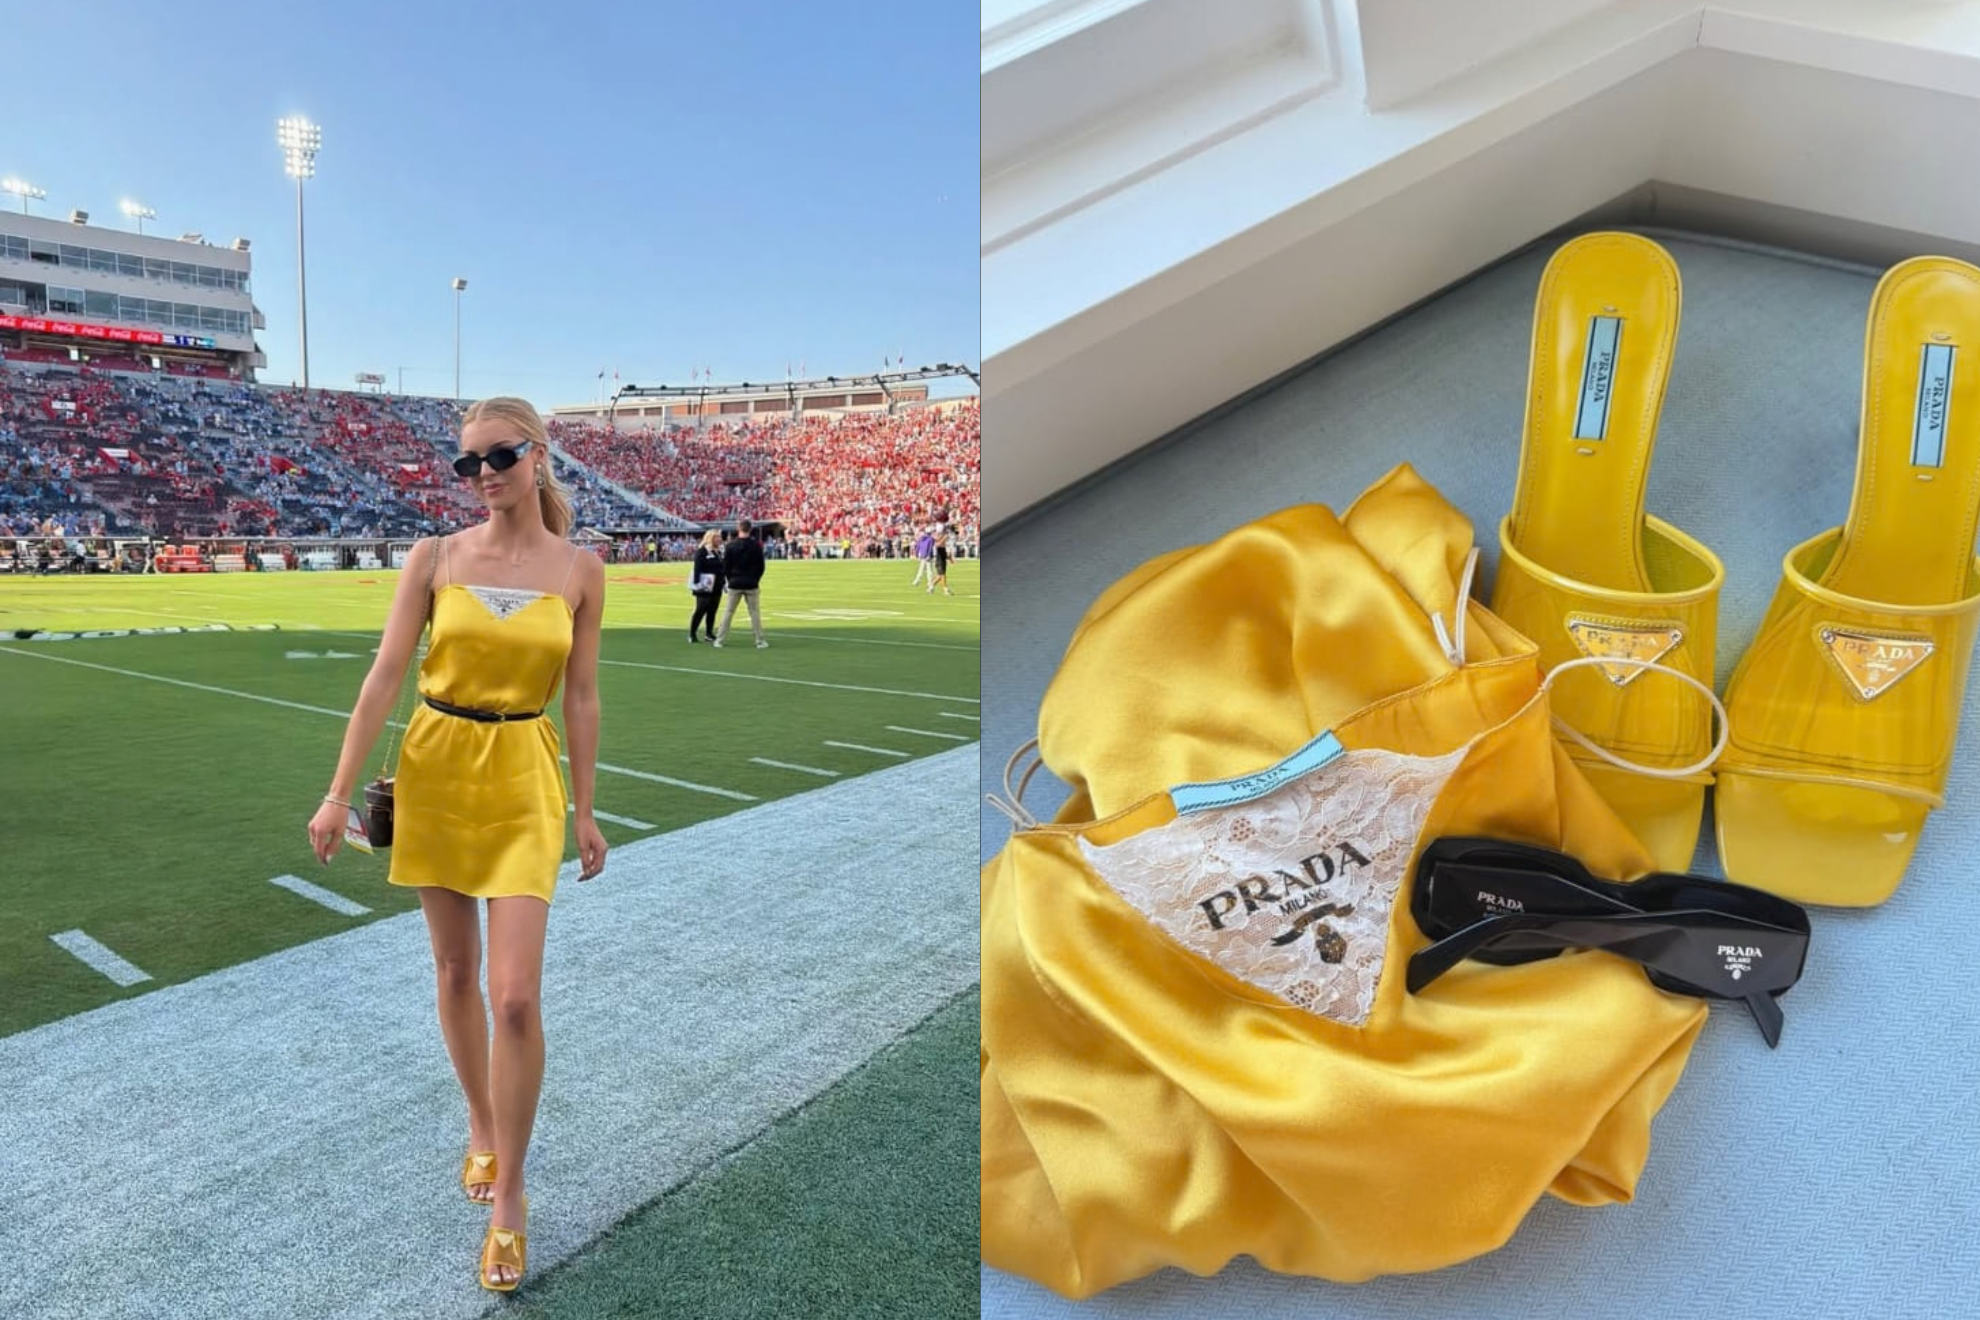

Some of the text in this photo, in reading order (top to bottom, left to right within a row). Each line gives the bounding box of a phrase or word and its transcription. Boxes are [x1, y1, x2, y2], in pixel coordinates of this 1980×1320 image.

[1594, 352, 1611, 402] PRADA
[1929, 376, 1945, 431] PRADA
[1230, 767, 1289, 791] PRADA
[1198, 841, 1372, 931] PRADA
[1279, 888, 1329, 916] MILANO
[1477, 890, 1525, 912] PRADA
[1717, 944, 1763, 958] PRADA
